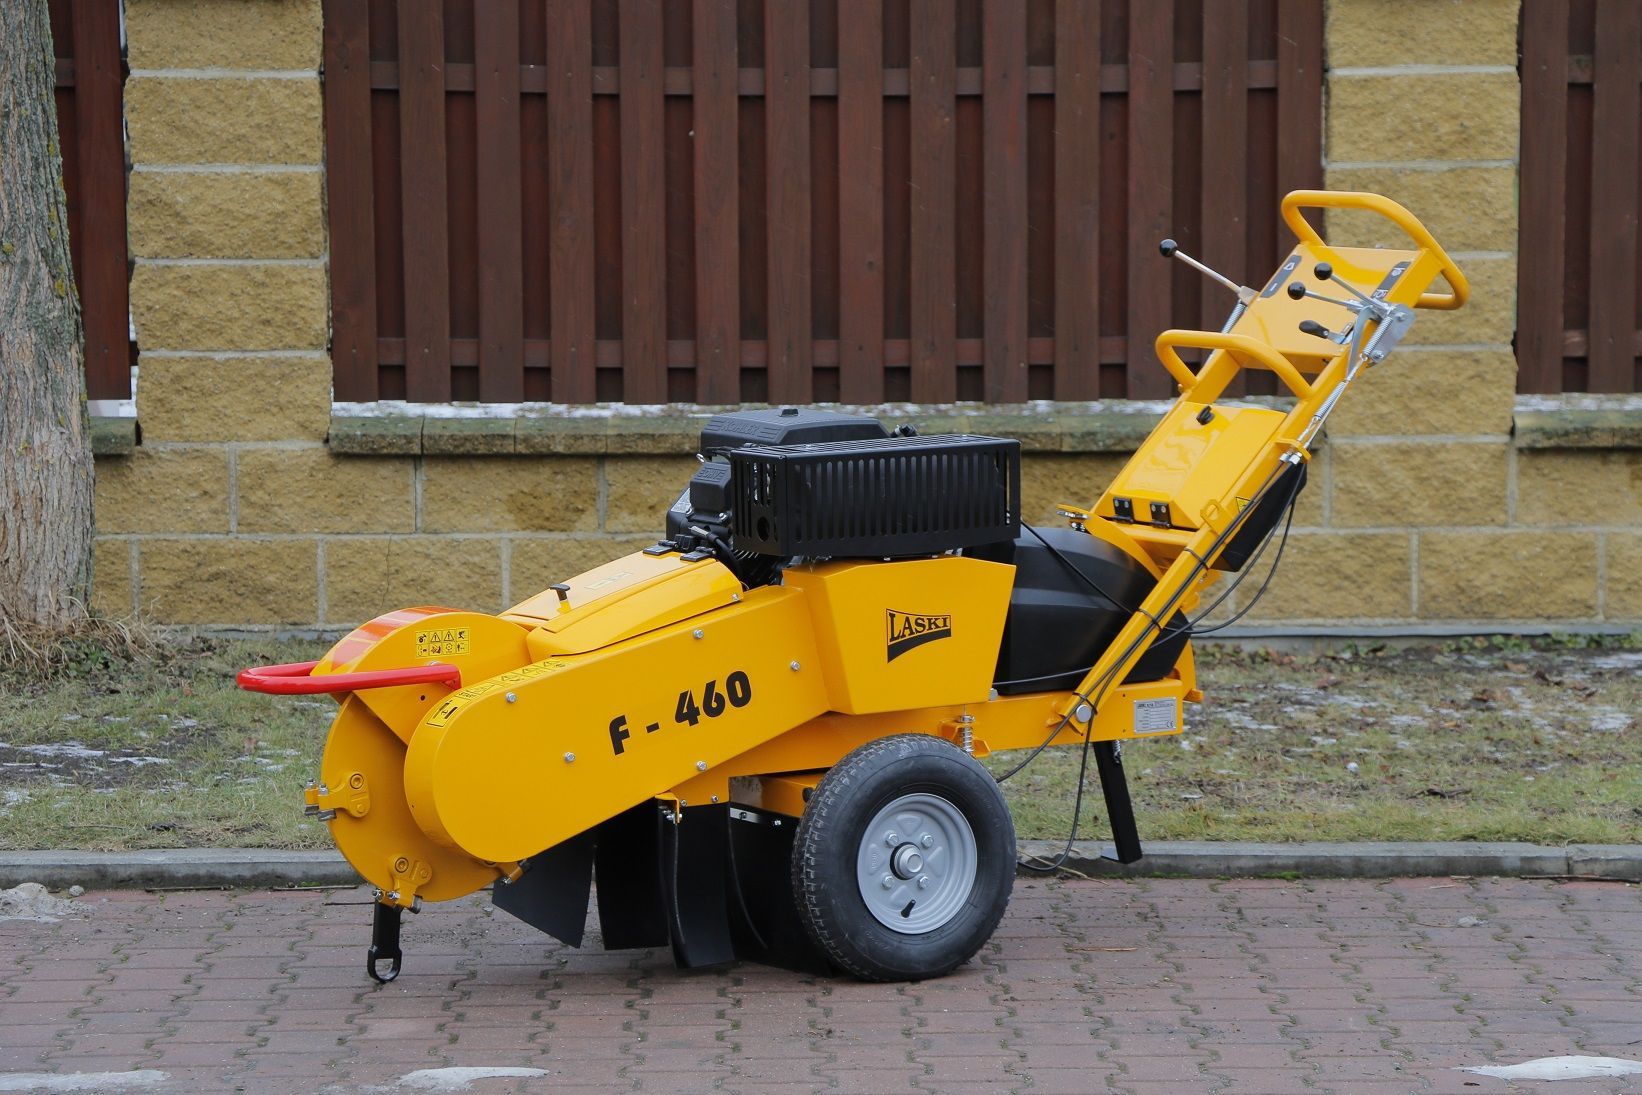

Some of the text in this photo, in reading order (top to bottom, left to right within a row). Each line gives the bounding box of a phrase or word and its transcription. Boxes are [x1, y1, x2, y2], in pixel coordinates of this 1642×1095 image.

[720, 420, 760, 436] KOHLER
[888, 611, 949, 643] LASKI
[608, 714, 631, 756] F
[674, 670, 752, 727] 460
